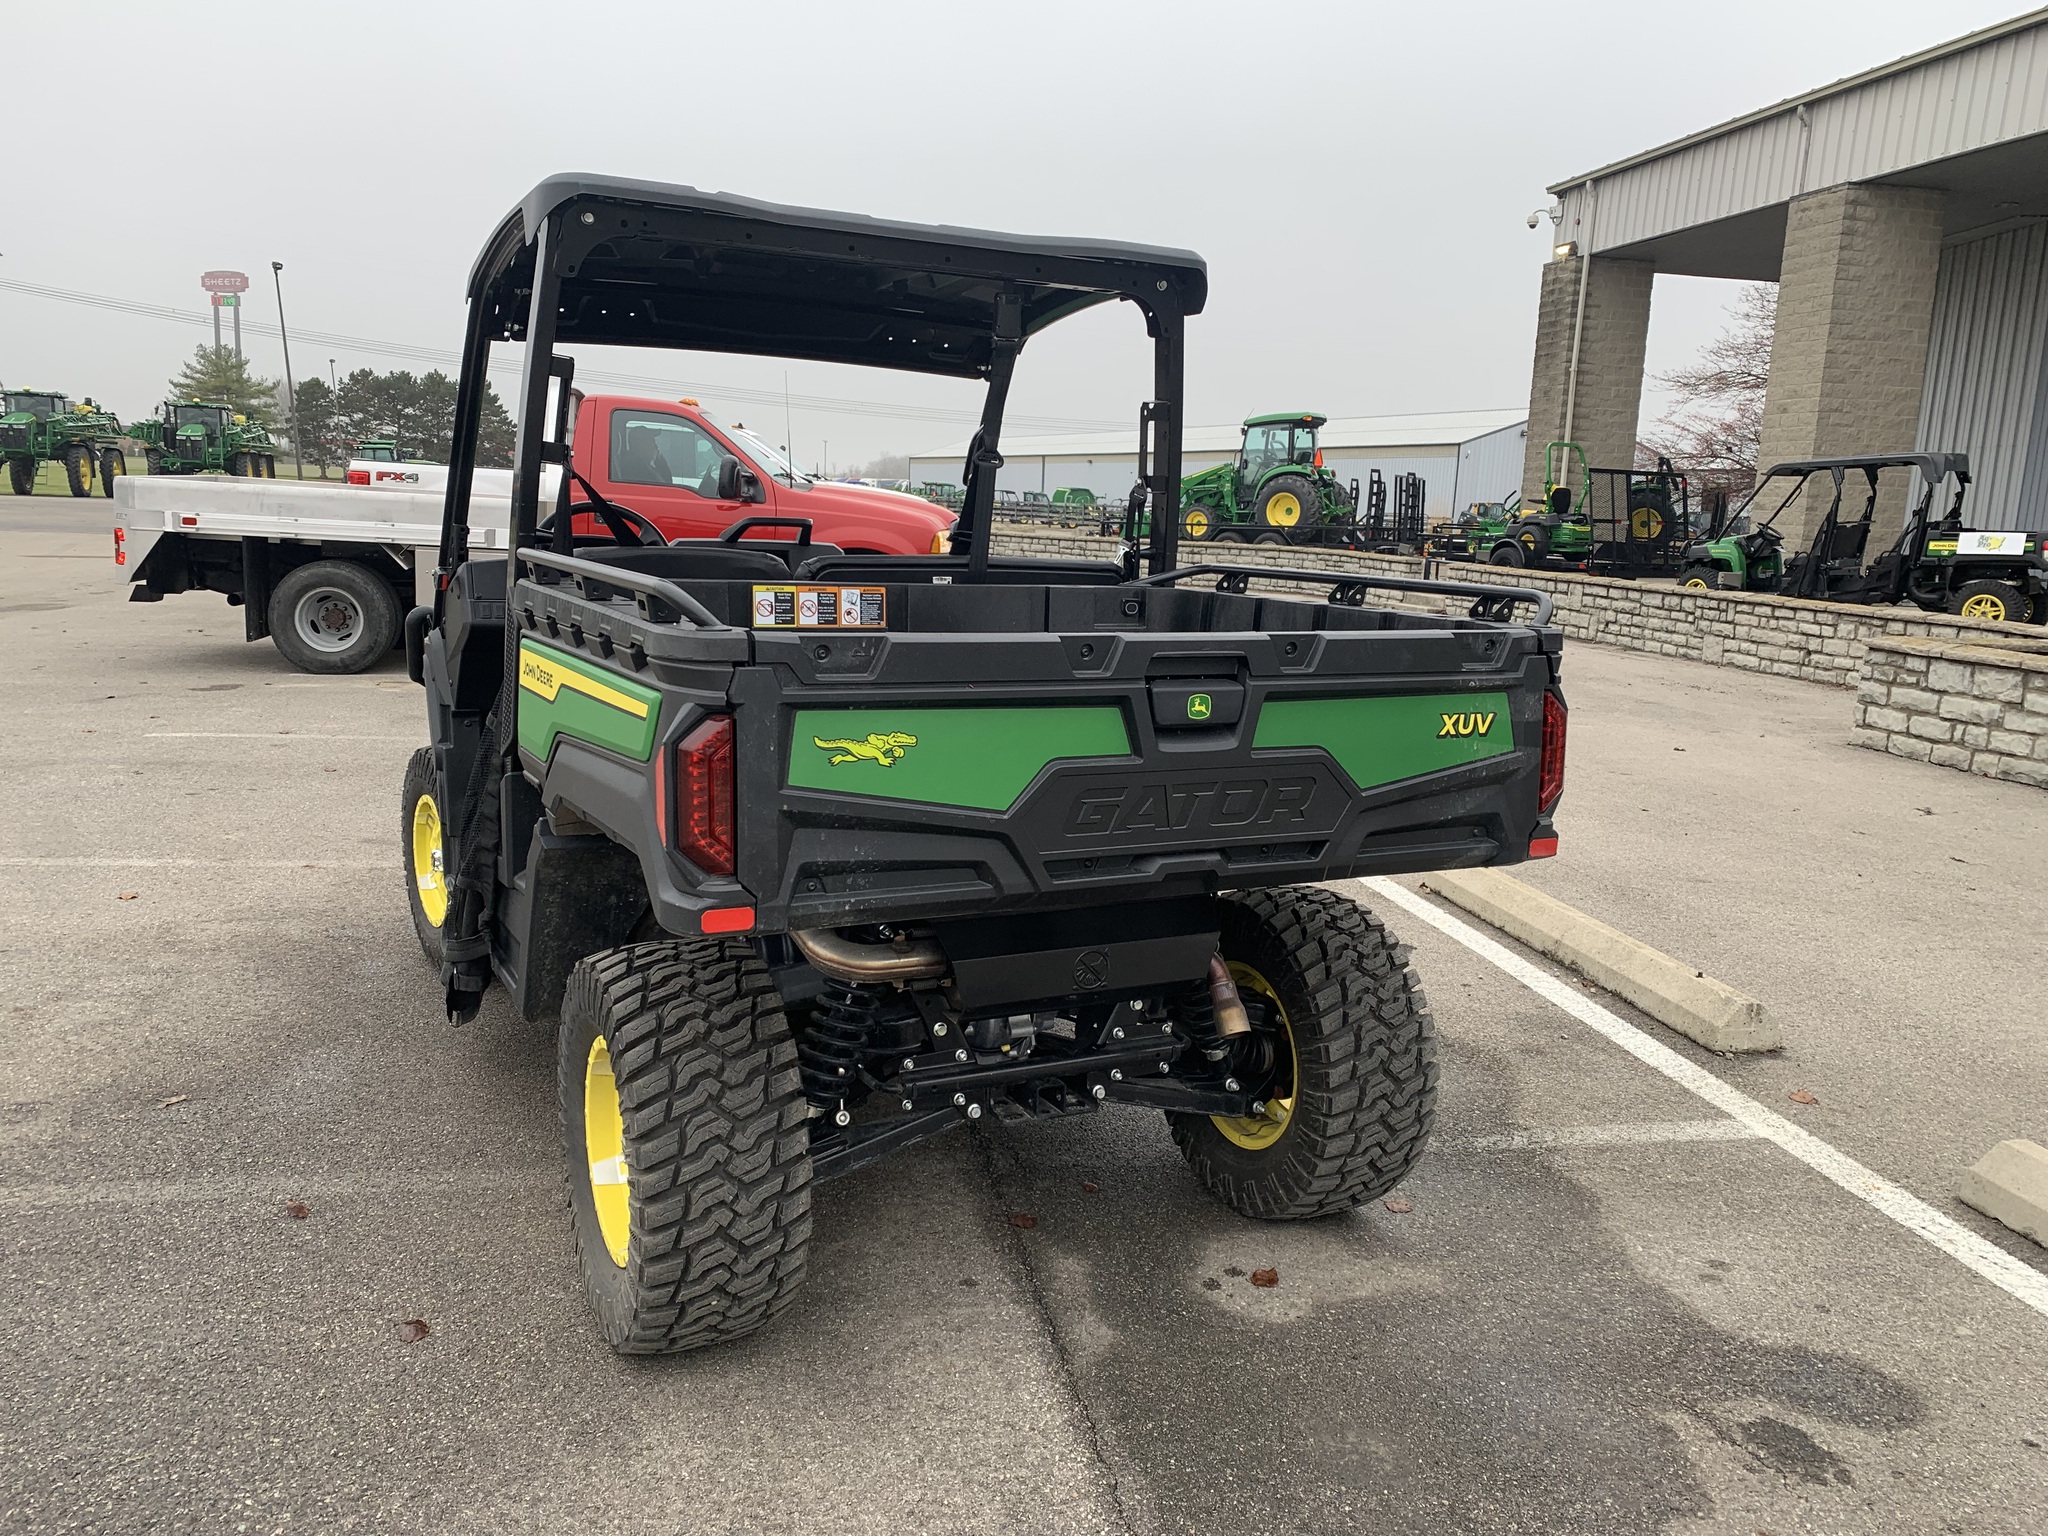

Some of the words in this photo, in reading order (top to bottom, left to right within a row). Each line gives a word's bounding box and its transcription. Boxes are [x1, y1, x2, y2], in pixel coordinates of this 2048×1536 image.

[204, 278, 241, 286] SHEETZ
[376, 471, 419, 481] FX4
[523, 658, 536, 680] JOHN
[537, 664, 553, 689] DEERE
[1436, 712, 1497, 739] XUV
[1063, 776, 1317, 837] GATOR
